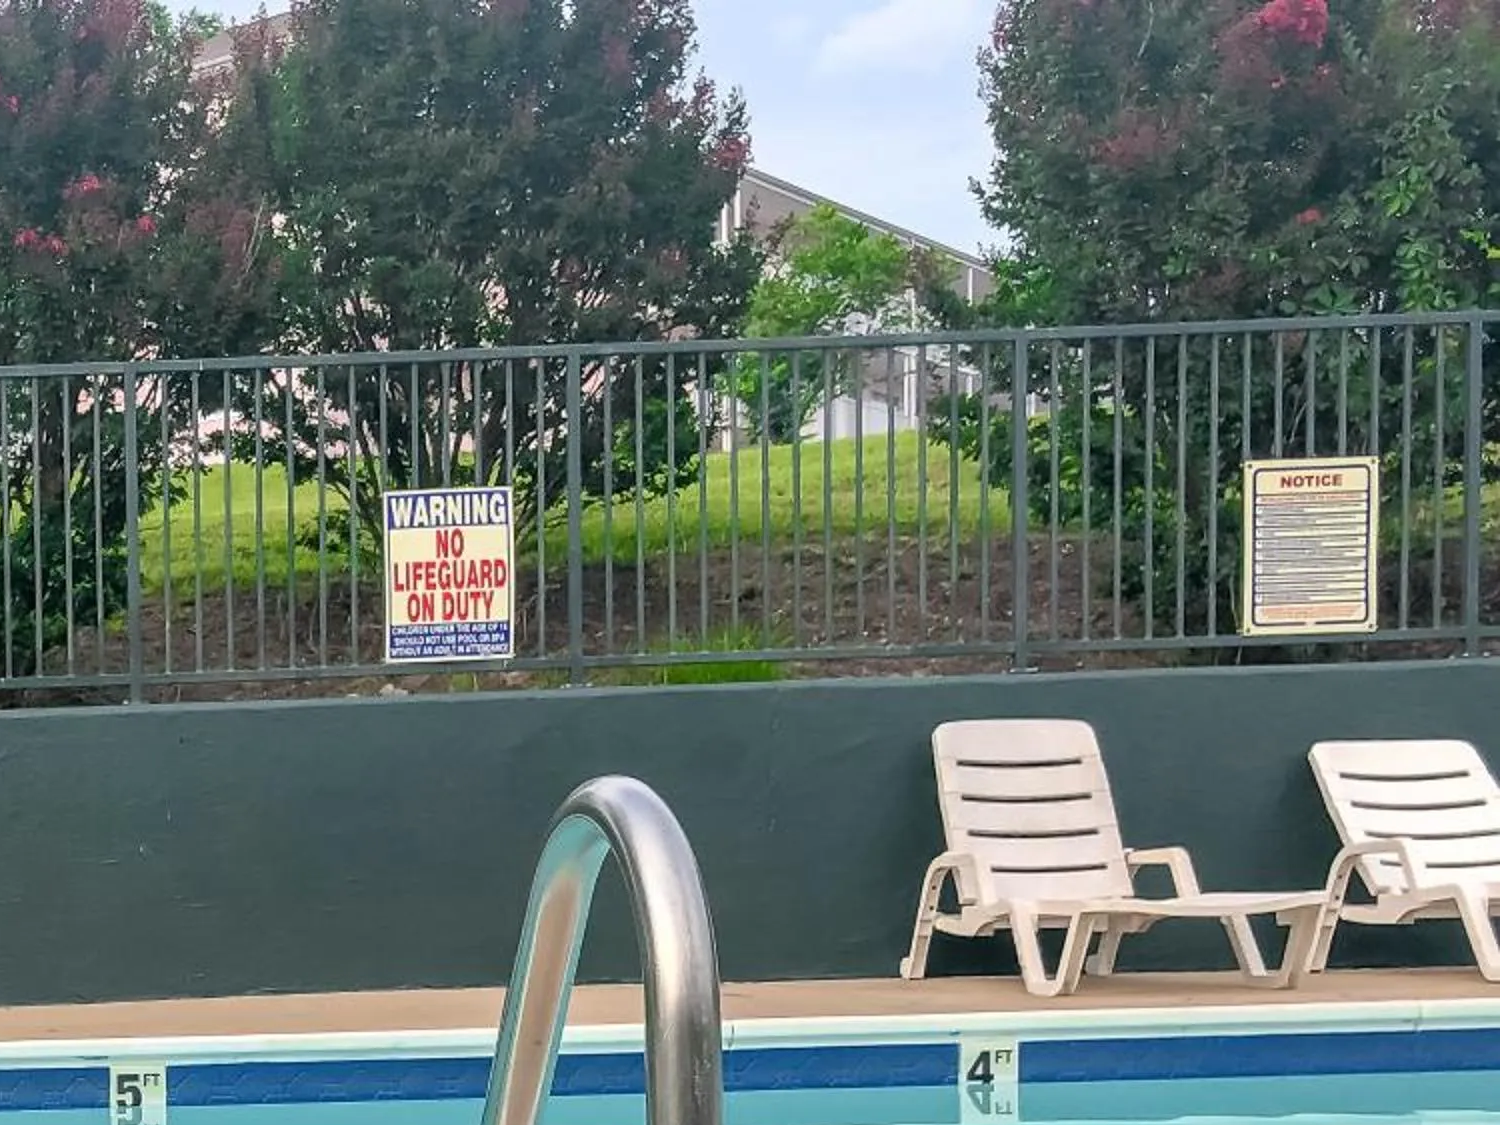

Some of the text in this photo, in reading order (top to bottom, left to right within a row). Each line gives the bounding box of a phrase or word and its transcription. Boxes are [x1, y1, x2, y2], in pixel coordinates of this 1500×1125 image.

[1280, 474, 1343, 489] NOTICE
[391, 493, 506, 527] WARNING
[436, 528, 464, 559] NO
[393, 559, 506, 592] LIFEGUARD
[407, 590, 495, 622] ON DUTY
[966, 1049, 1012, 1084] 4 FT
[117, 1073, 160, 1107] 5 FT
